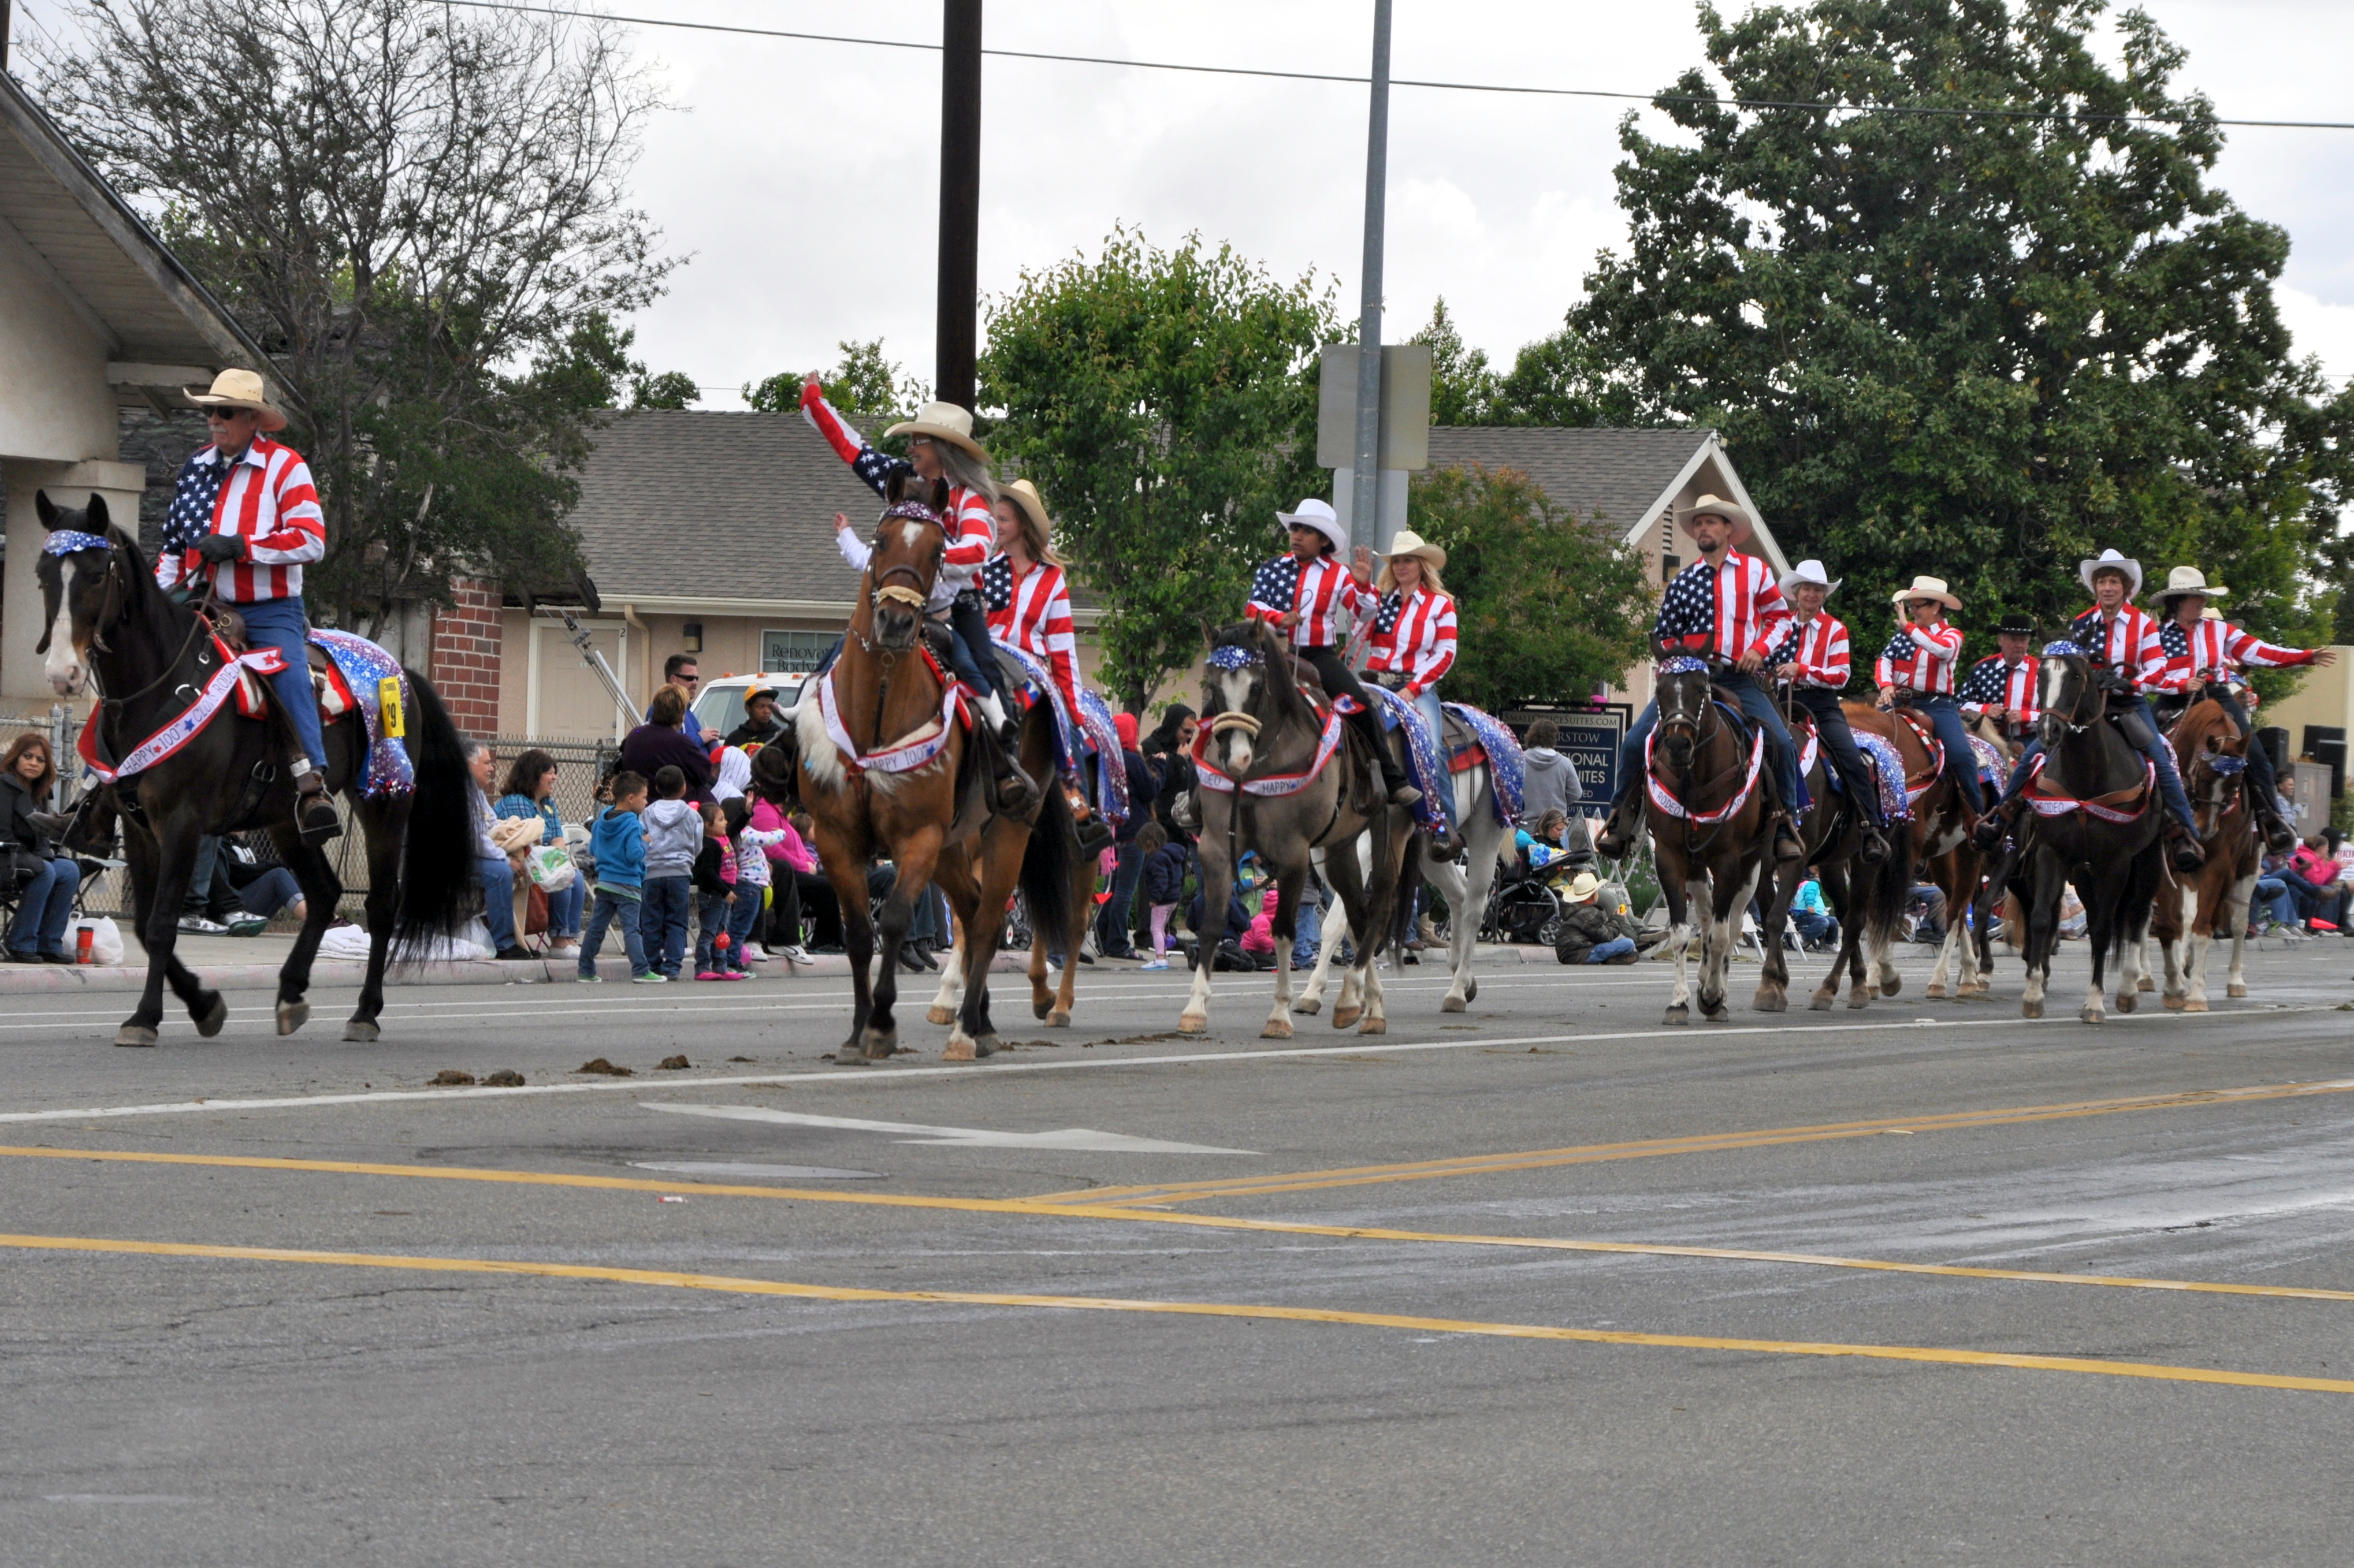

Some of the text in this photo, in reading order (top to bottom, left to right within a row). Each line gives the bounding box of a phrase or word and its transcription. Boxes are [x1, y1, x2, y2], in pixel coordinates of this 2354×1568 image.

[620, 628, 626, 638] 2
[772, 644, 827, 658] Renova
[123, 744, 155, 774] HAPPY
[212, 664, 240, 695] RODEO
[1578, 770, 1605, 784] UITES
[1263, 781, 1291, 794] HAPPY
[1656, 791, 1681, 815] RODEO
